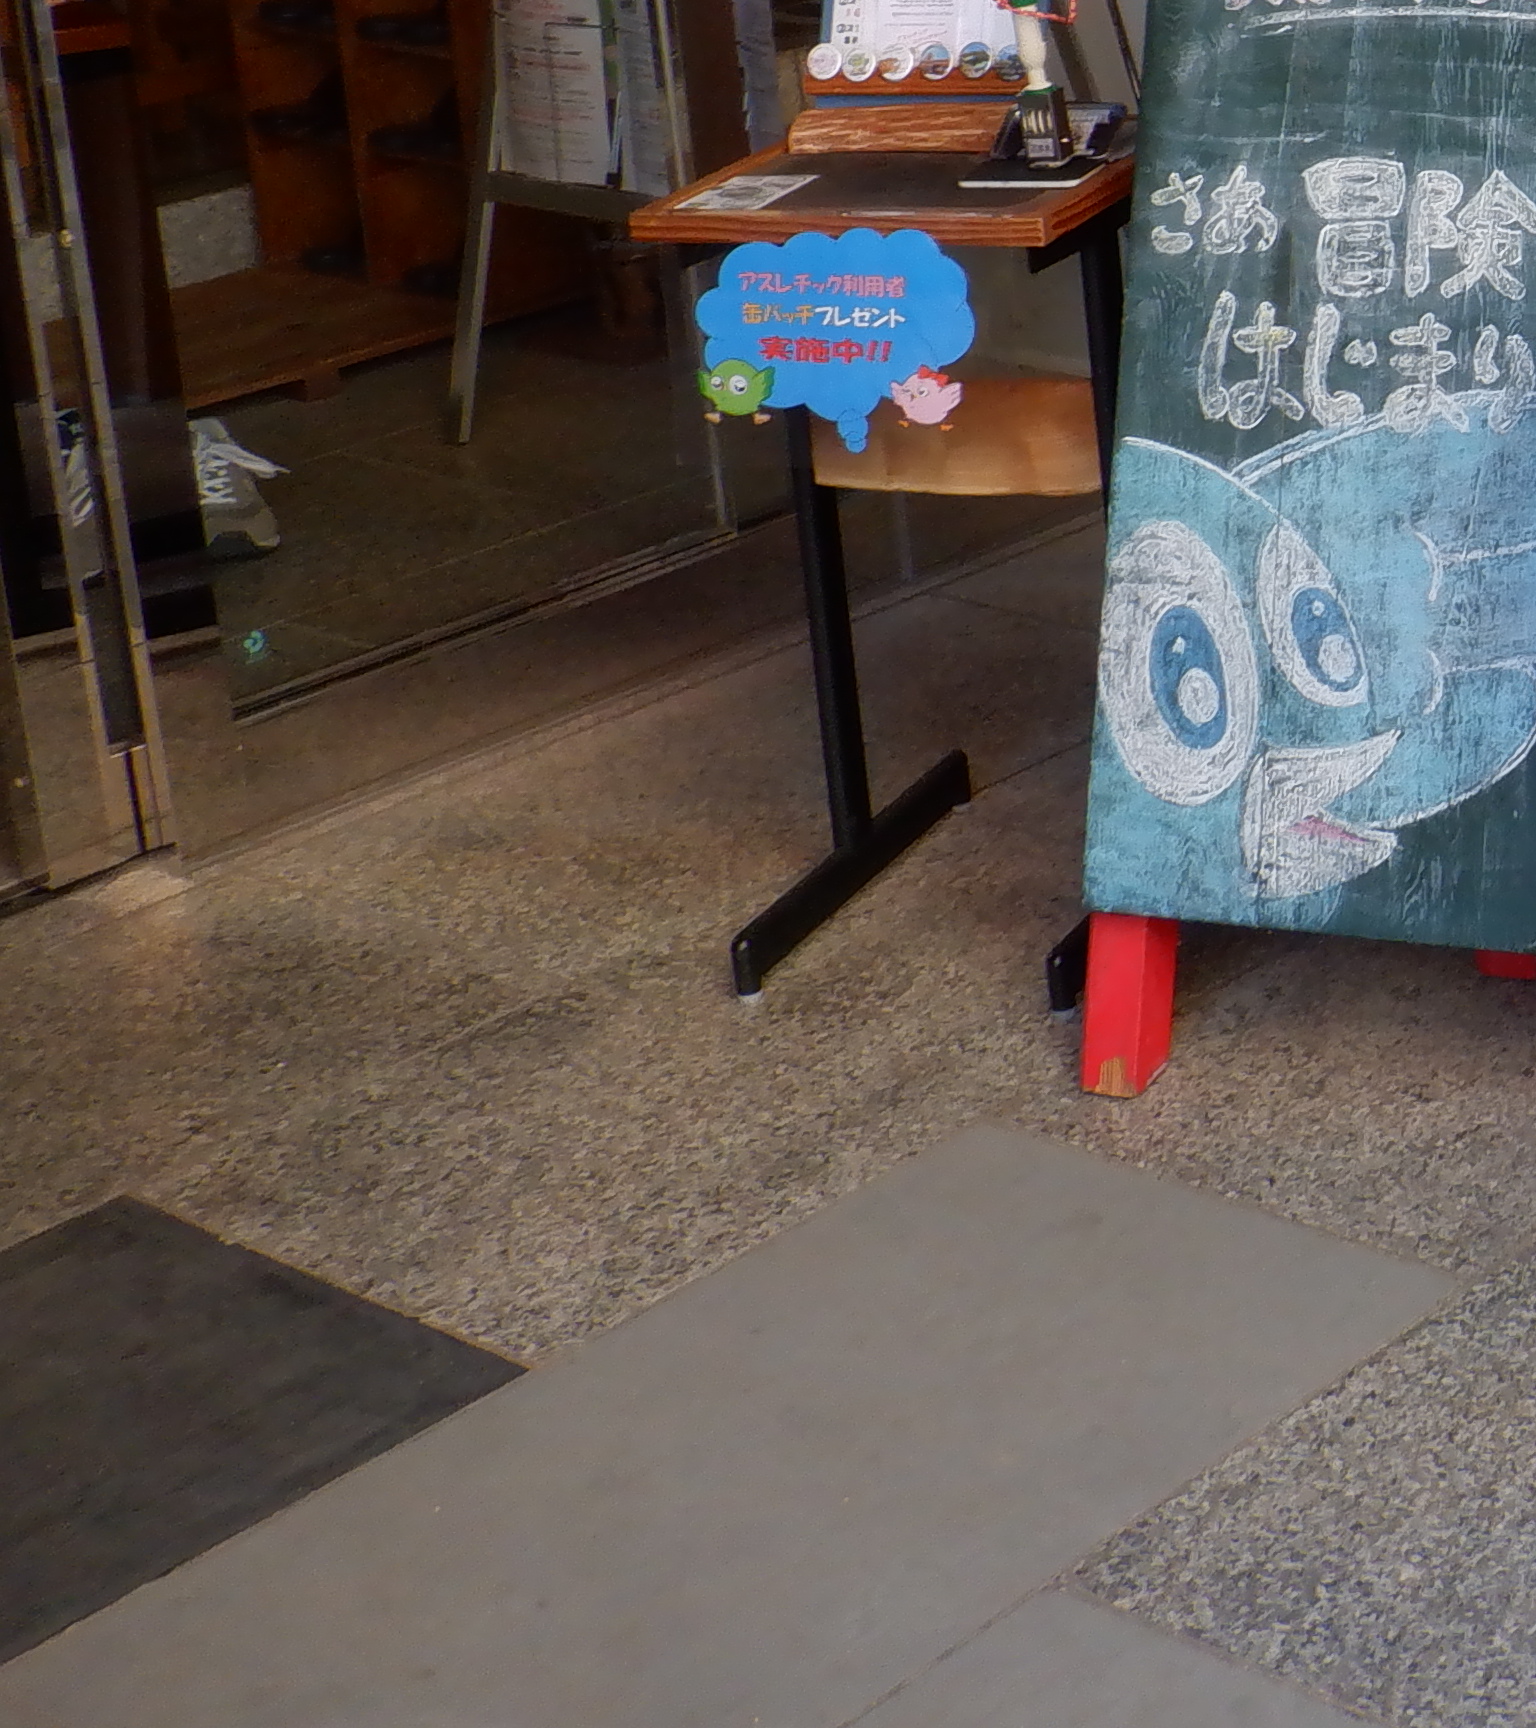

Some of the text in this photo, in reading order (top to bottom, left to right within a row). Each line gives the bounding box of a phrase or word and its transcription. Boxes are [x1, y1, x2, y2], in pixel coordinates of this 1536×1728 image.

[738, 271, 906, 298] アスレチック利用者
